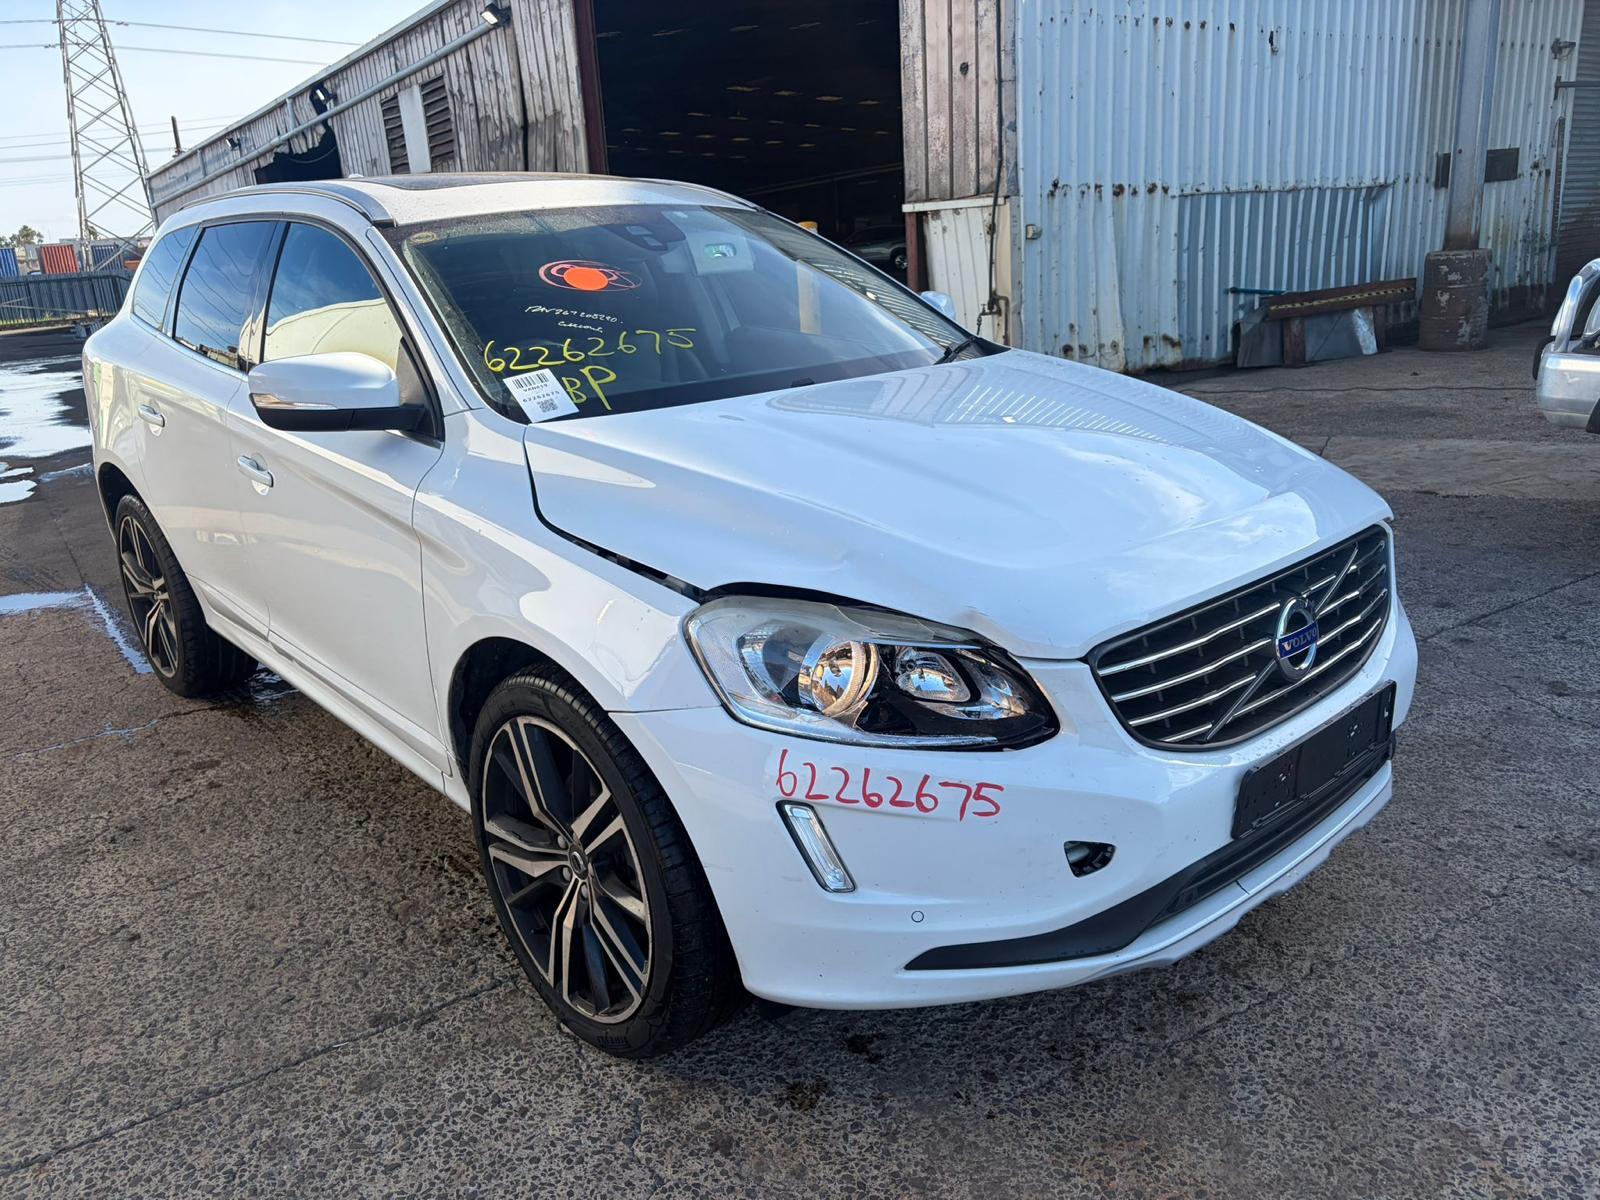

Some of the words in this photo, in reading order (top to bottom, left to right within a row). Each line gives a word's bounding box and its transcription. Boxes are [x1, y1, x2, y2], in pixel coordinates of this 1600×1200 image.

[484, 328, 696, 372] 62262675
[561, 365, 617, 410] BP
[1282, 627, 1317, 651] VOLVO
[776, 749, 1004, 821] 62262675
